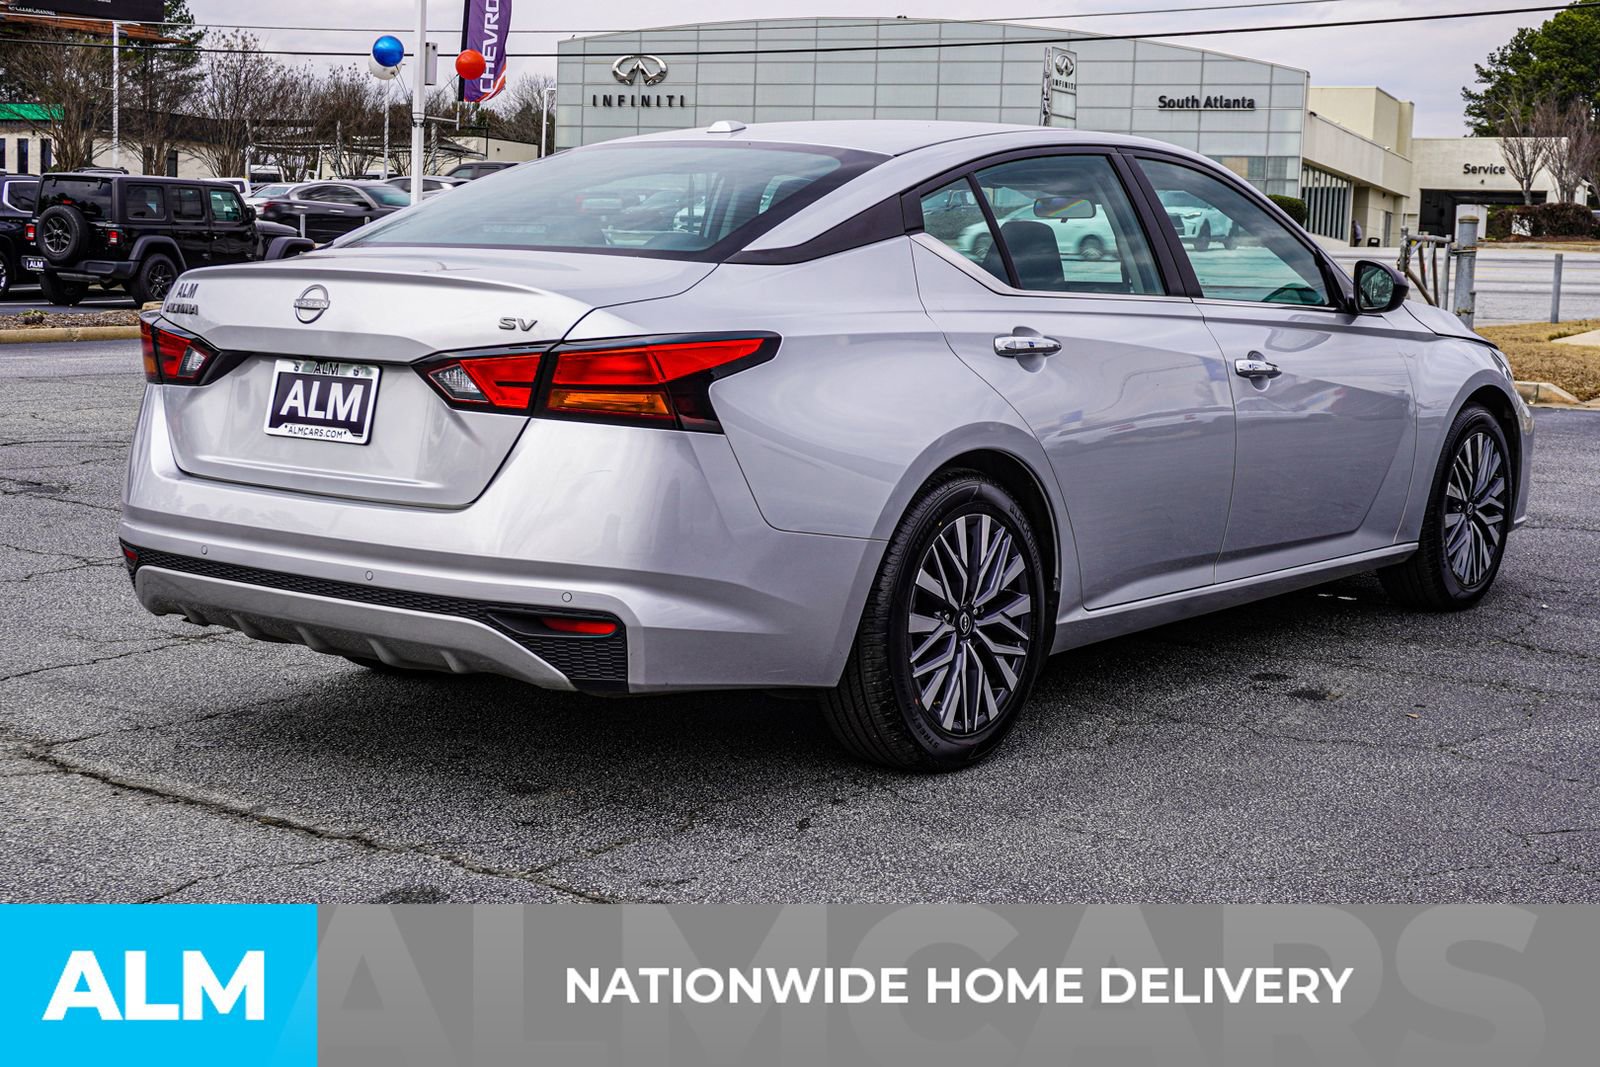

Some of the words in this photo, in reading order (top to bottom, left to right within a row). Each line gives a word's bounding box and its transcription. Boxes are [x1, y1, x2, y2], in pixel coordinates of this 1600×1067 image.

[1052, 79, 1077, 91] INFINITI
[592, 94, 685, 108] INFINITI
[1158, 95, 1200, 109] South
[1203, 95, 1256, 109] Atlanta
[1463, 163, 1506, 175] Service
[29, 260, 44, 268] ALM
[176, 283, 199, 299] ALM
[498, 316, 538, 332] SV
[313, 361, 340, 376] ALM
[279, 379, 365, 423] ALM
[288, 426, 344, 439] ALMCARS.COM
